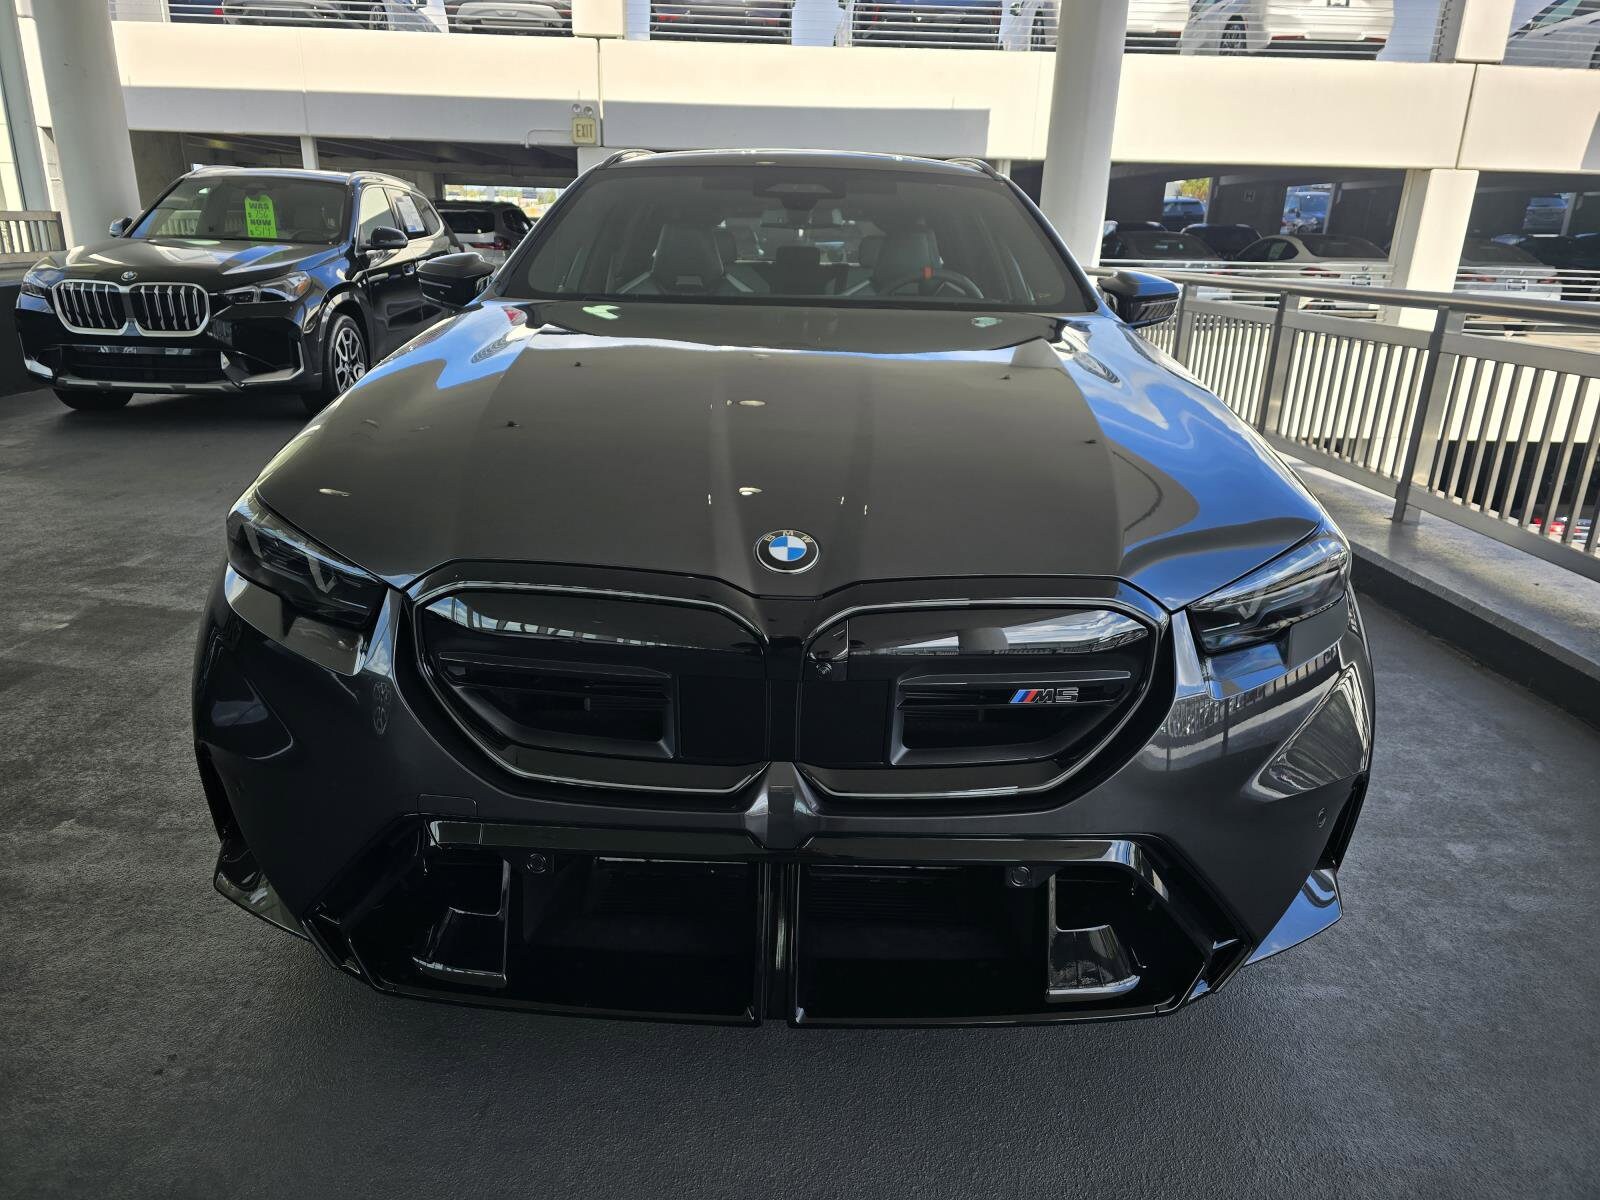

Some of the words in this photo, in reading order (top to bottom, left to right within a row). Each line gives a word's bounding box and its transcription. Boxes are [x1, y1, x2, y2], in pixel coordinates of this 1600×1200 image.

[576, 123, 594, 138] EXIT
[248, 202, 270, 210] WAS
[764, 530, 813, 543] BMW
[1032, 687, 1079, 704] M5
